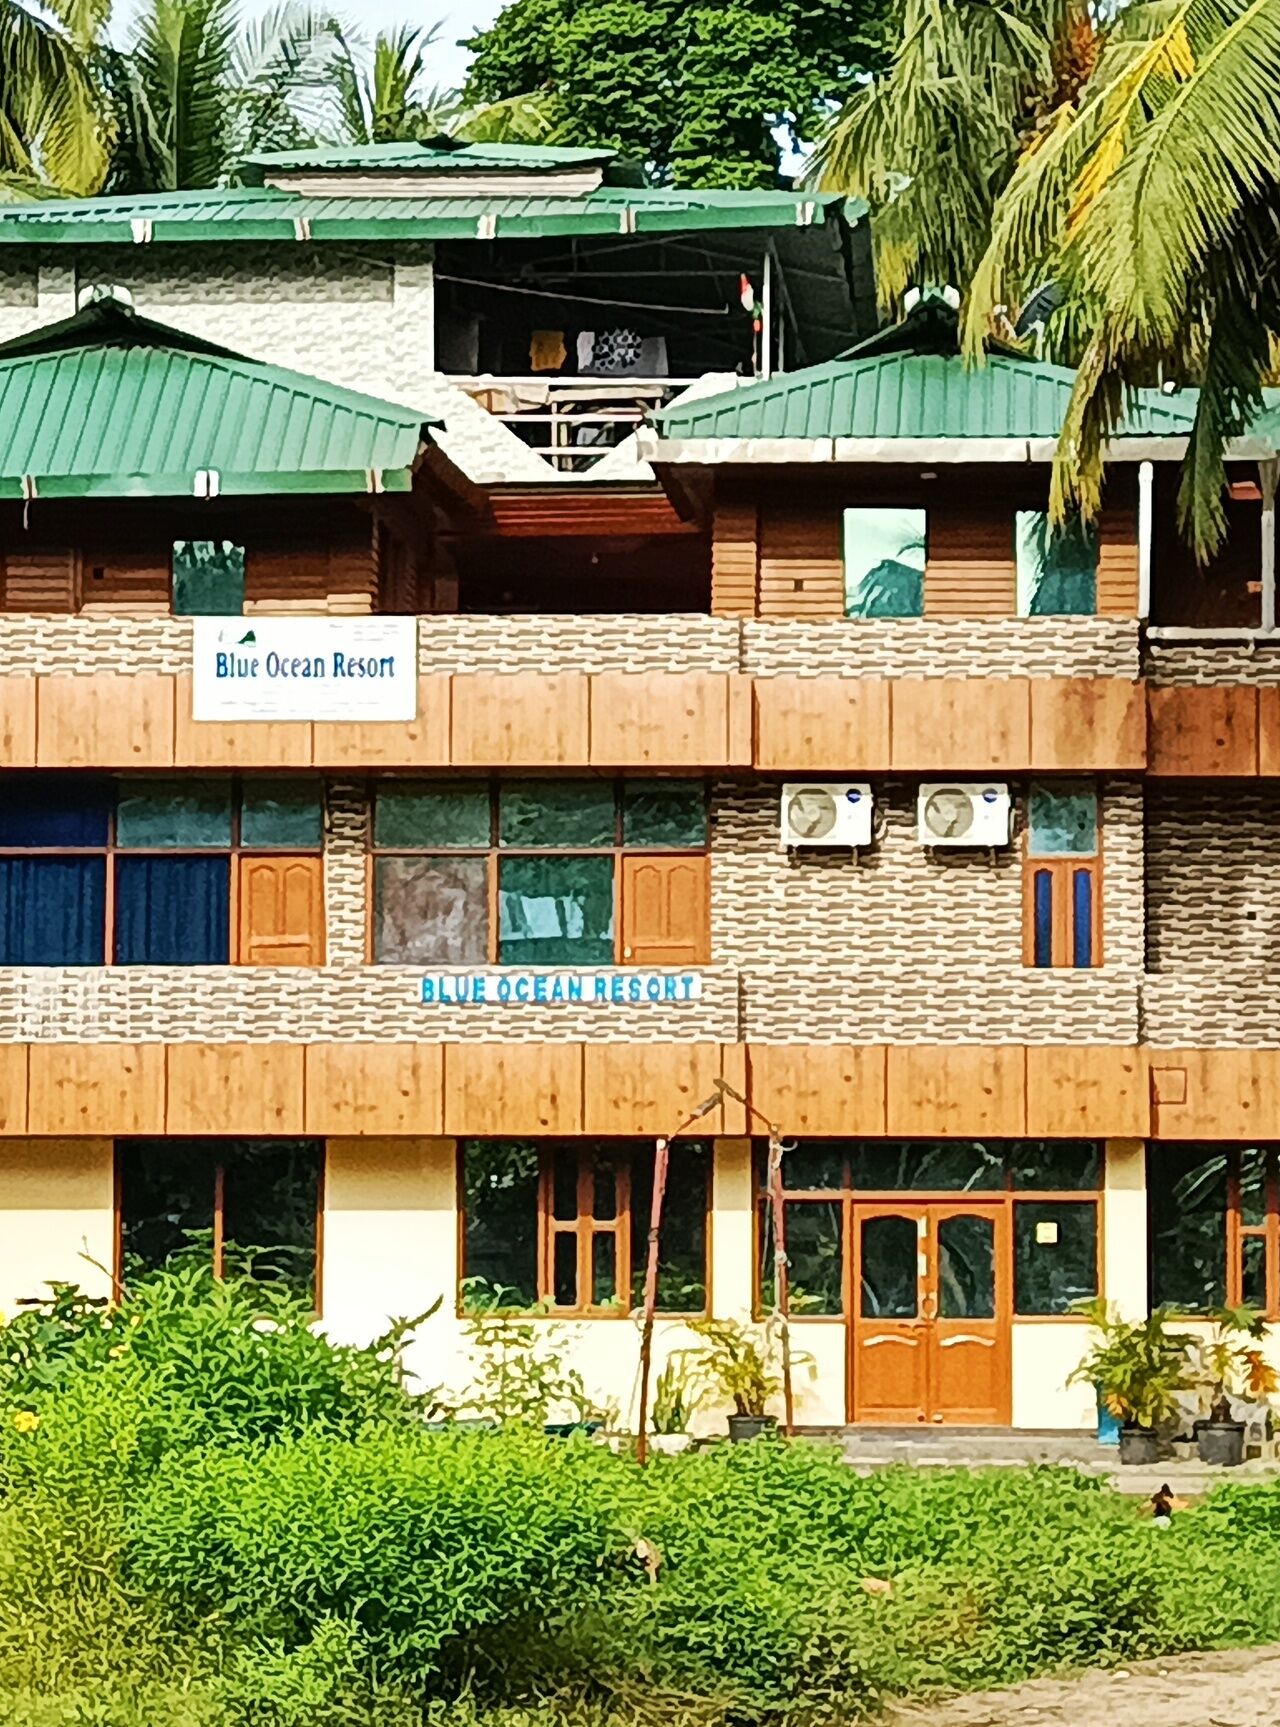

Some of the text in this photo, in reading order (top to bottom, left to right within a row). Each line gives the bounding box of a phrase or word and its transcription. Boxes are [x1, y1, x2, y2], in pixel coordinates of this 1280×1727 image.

[216, 651, 394, 678] Blue Ocean Resort
[421, 975, 693, 1003] BLUE OCEAN RESORT
